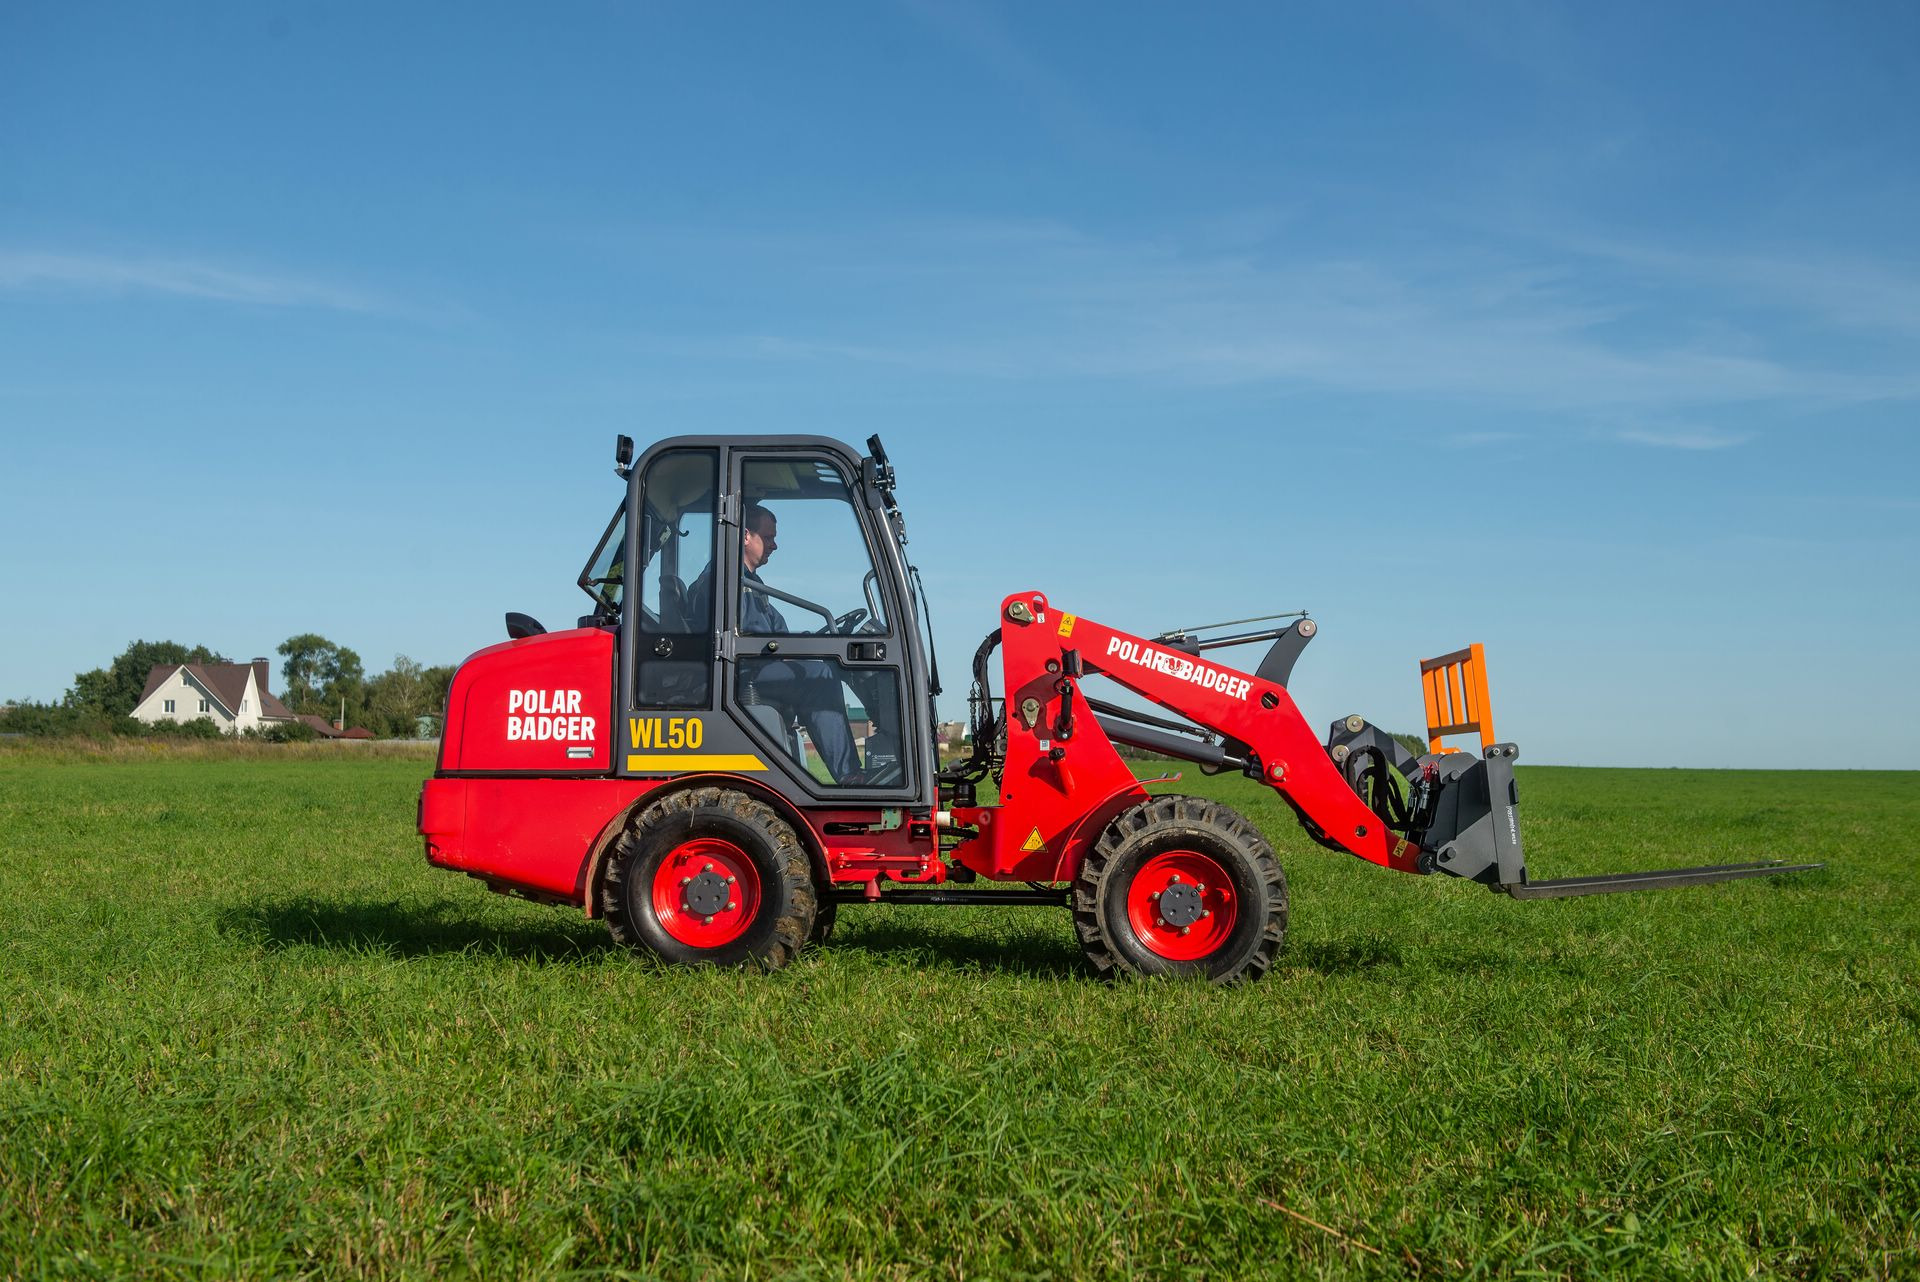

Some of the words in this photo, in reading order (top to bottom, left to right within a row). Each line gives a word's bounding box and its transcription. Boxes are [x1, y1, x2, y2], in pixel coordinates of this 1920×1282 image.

[1106, 636, 1165, 672] POLAR
[1182, 659, 1251, 701] BADGER
[508, 689, 582, 714] POLAR
[507, 716, 596, 741] BADGER
[629, 717, 704, 749] WL50
